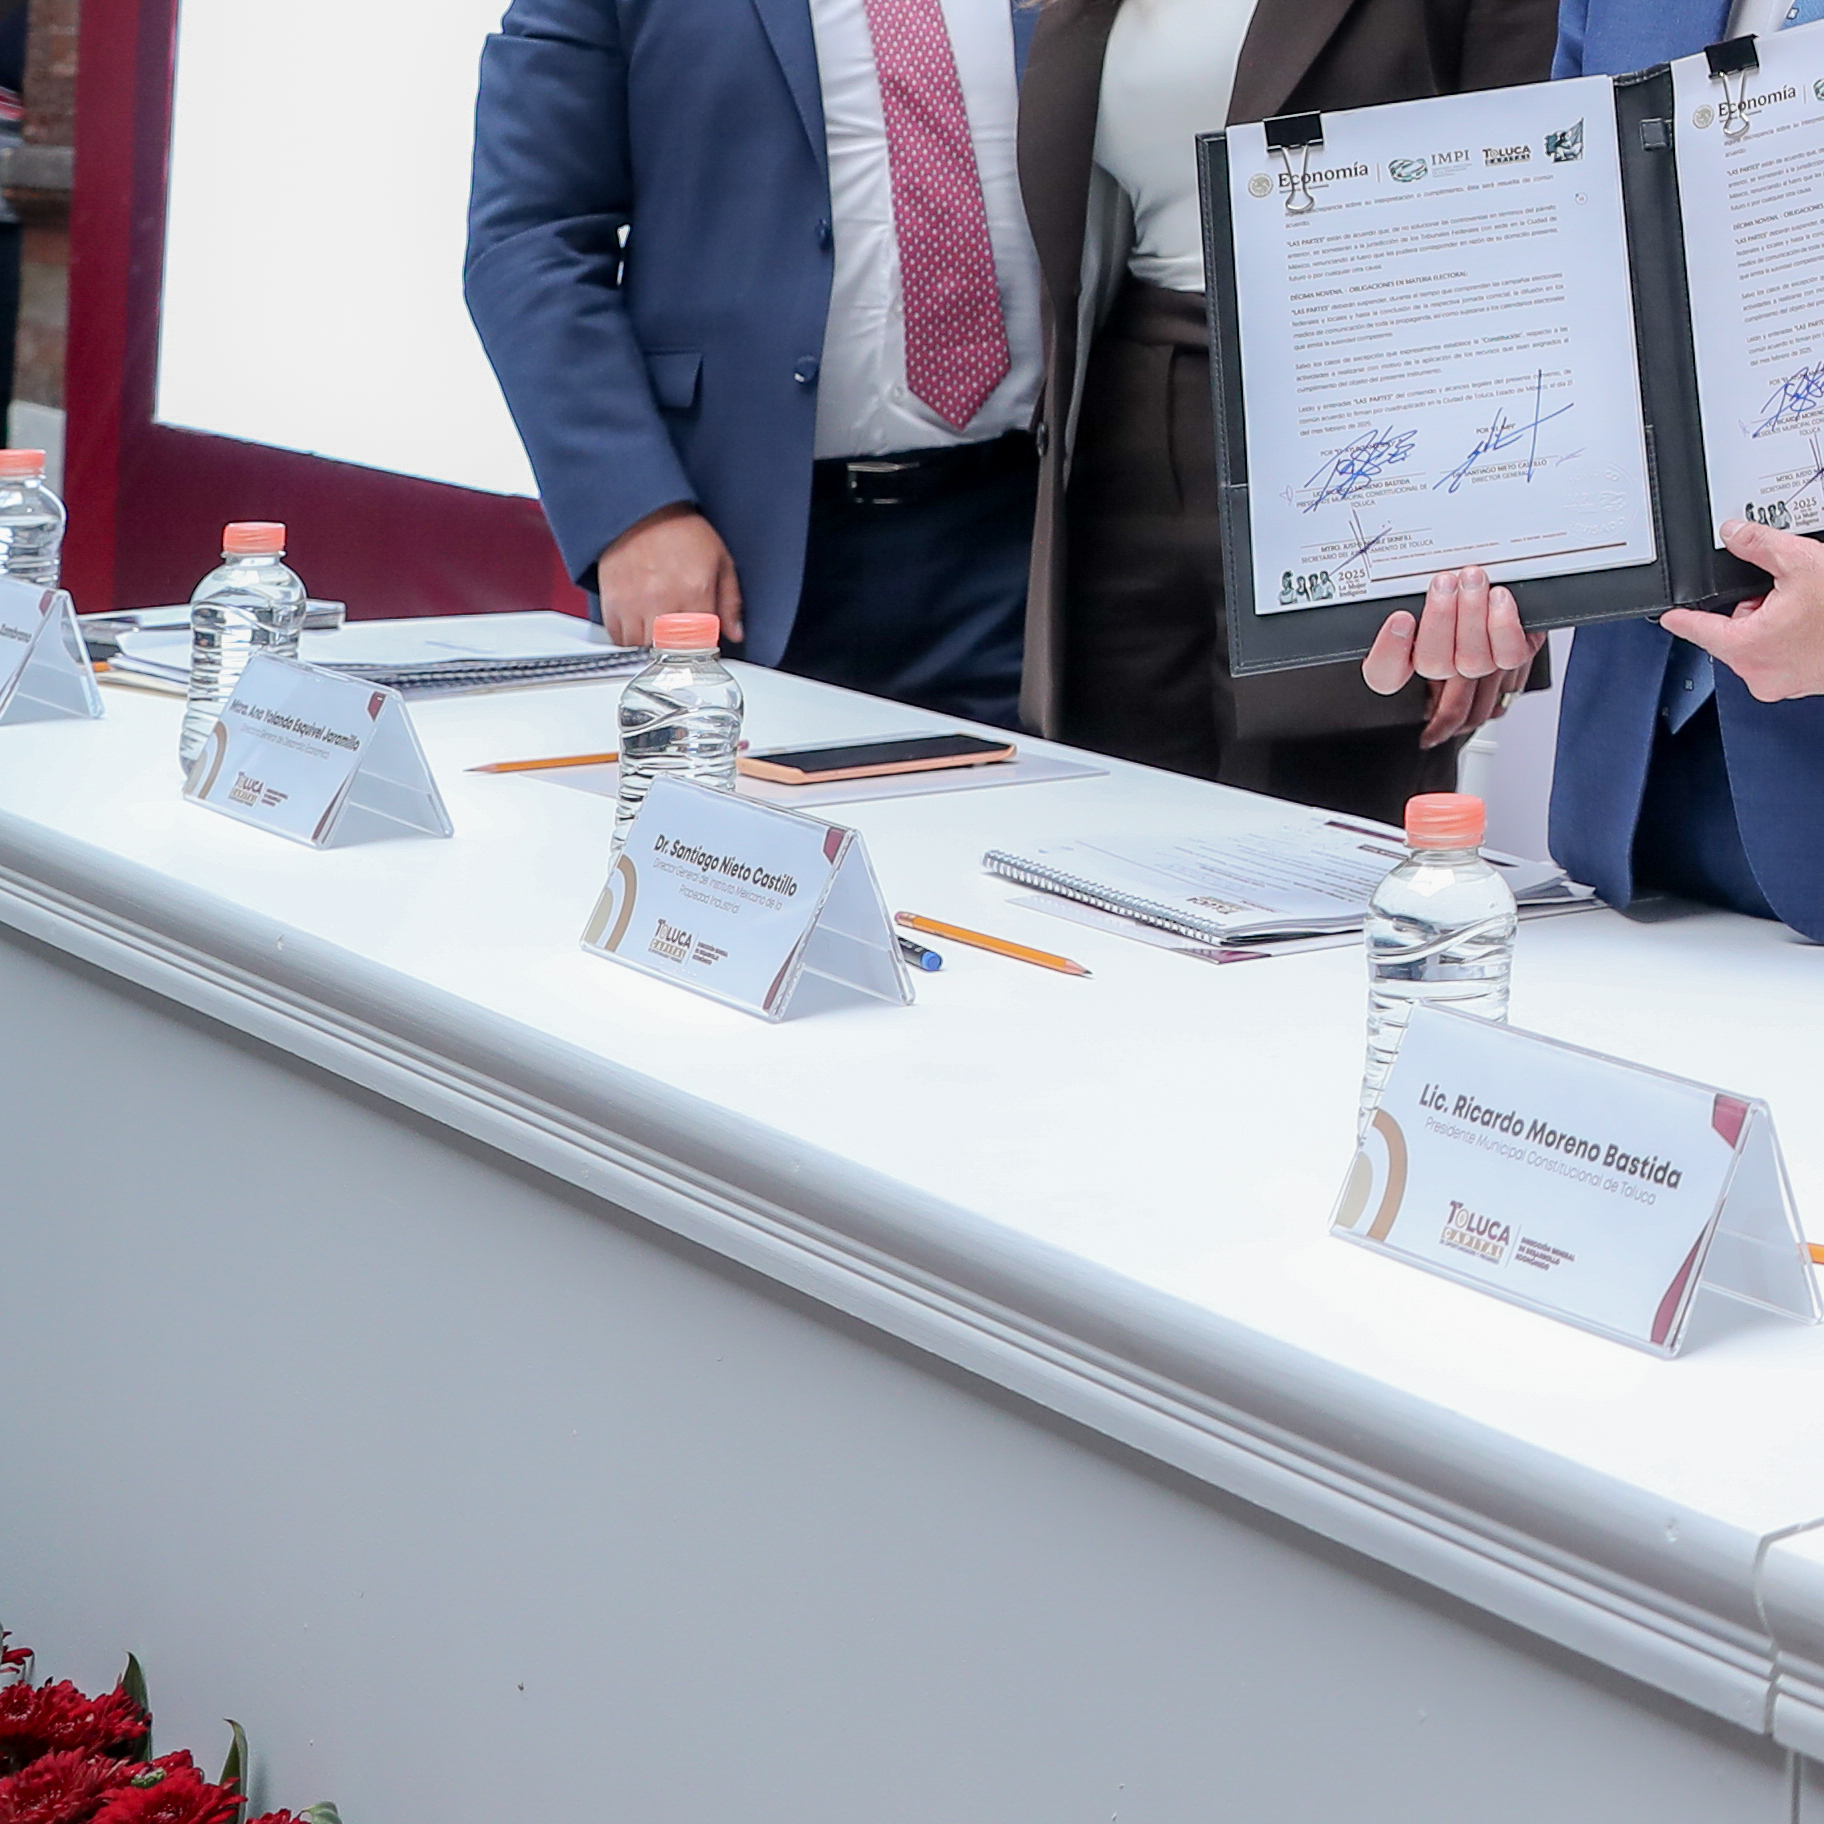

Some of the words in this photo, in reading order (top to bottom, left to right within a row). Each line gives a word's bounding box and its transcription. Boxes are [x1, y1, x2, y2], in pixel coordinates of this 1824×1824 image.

[1718, 85, 1797, 118] Economía
[1278, 160, 1369, 188] Economía
[1431, 148, 1471, 167] IMPI
[1482, 143, 1531, 161] TOLUCA
[653, 833, 670, 855] Dr.
[669, 838, 721, 873] Santiago
[718, 855, 752, 882] Nieto
[752, 866, 798, 898] Castillo
[654, 918, 693, 950] TOLUCA
[1418, 1082, 1450, 1116] Lic.
[1452, 1091, 1525, 1139] Ricardo
[1524, 1117, 1602, 1164] Moreno
[1602, 1138, 1684, 1191] Bastida
[1424, 1115, 1476, 1145] Presidente
[1475, 1133, 1527, 1161] Municipal
[1526, 1149, 1604, 1187] Constitucional
[1601, 1176, 1619, 1193] de
[1619, 1180, 1657, 1206] Toluca
[1443, 1228, 1503, 1259] CAPITAL
[1448, 1199, 1511, 1246] TOLUCA
